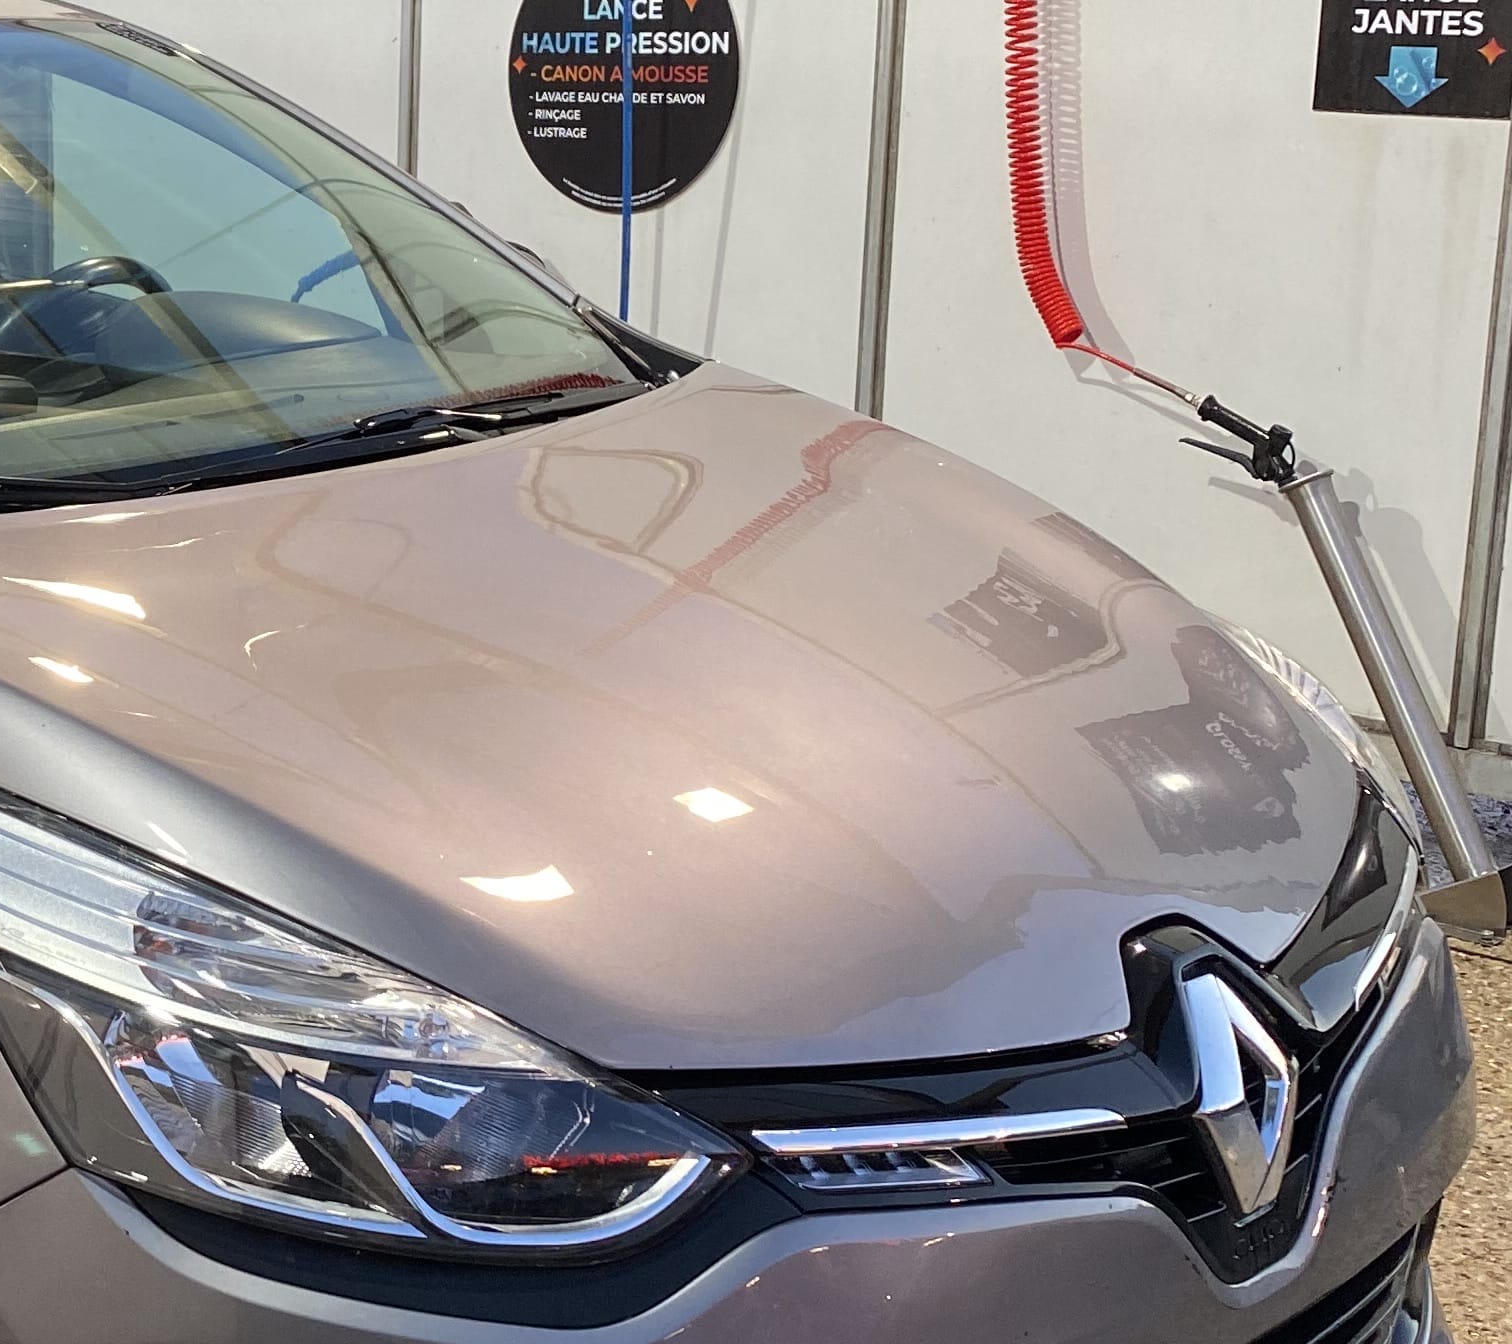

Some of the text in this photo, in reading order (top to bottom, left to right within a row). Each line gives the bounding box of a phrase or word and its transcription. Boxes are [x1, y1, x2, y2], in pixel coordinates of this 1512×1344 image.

[1351, 8, 1485, 37] JANTES
[522, 31, 598, 54] HAUTE
[541, 64, 606, 82] CANON
[630, 66, 709, 83] MOUSSE
[535, 91, 576, 103] LAVAGE
[578, 92, 599, 103] EAU
[602, 92, 648, 104] CHADE
[650, 93, 664, 104] ET
[666, 93, 705, 105] SAVON
[535, 109, 581, 122] RINÇAGE
[533, 126, 587, 138] LUSTRAGE
